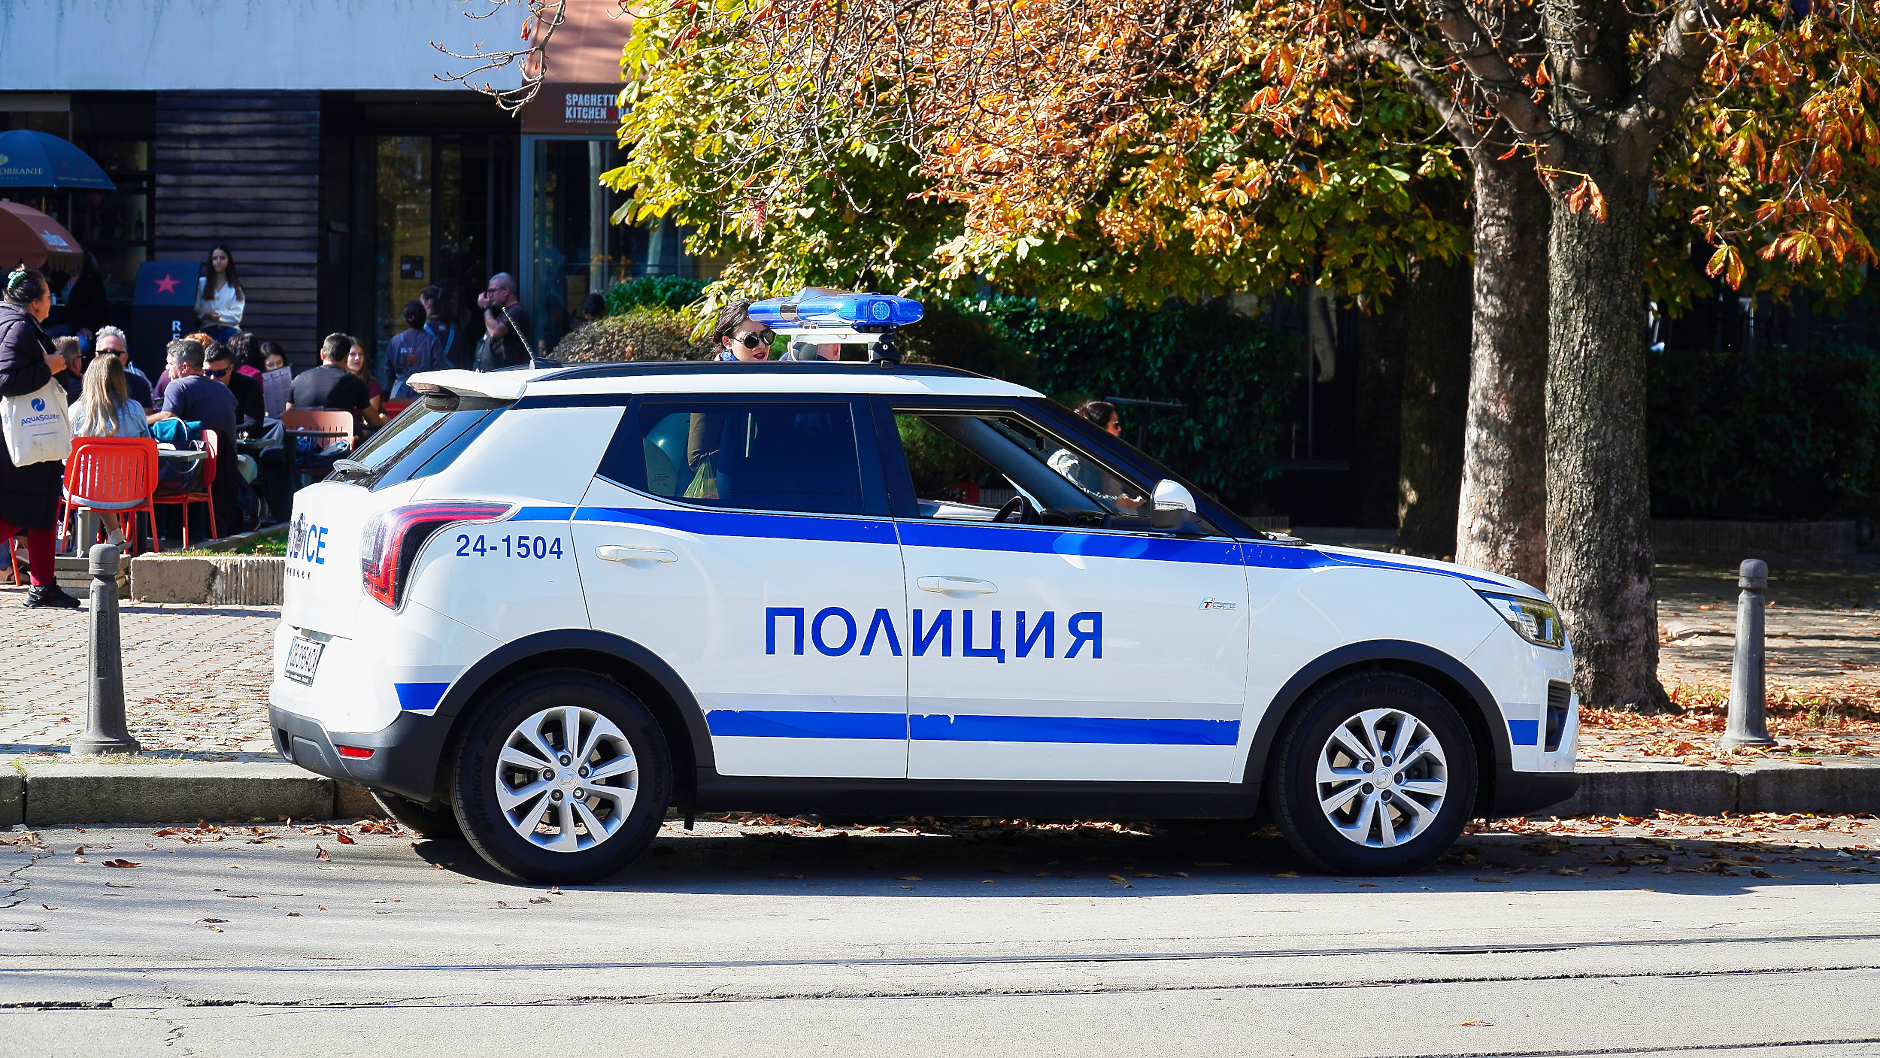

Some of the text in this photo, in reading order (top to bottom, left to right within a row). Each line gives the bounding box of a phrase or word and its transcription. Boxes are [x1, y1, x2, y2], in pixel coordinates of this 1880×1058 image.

[565, 107, 632, 120] KITCHEN BA
[456, 534, 563, 560] 24-1504
[765, 606, 1103, 664] ПОЛИЦИЯ
